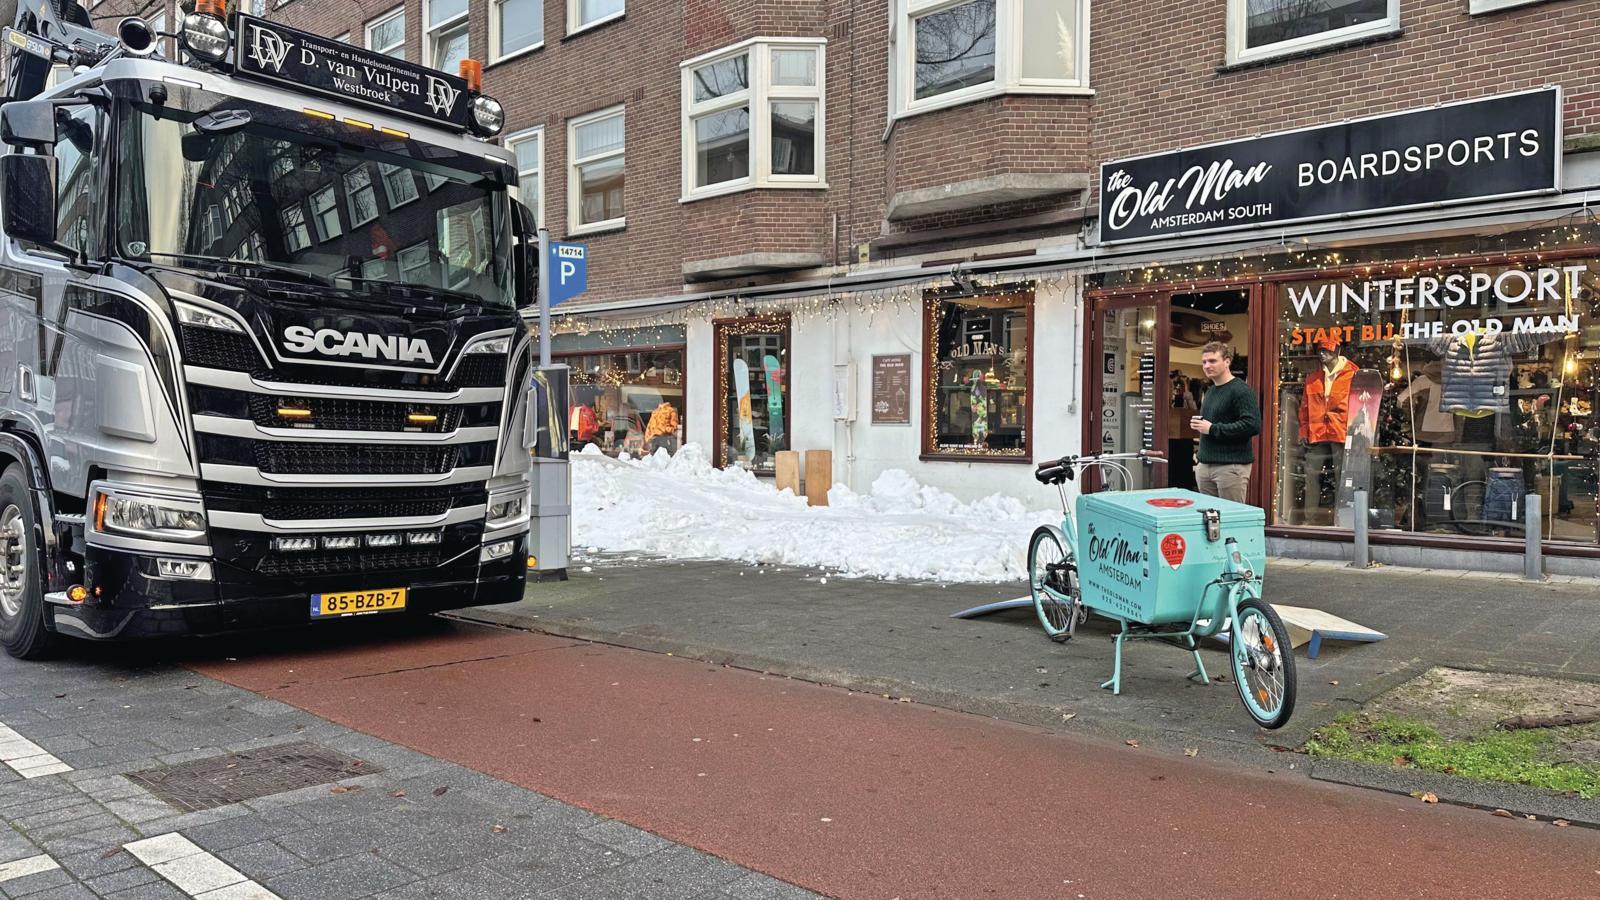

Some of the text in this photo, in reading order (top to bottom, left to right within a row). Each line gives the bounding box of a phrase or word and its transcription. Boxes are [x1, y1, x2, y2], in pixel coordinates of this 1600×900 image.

[300, 39, 420, 80] Transport- en Handelsonderneming
[300, 48, 420, 95] D. van Vulpen
[332, 76, 391, 103] Westbroek
[1298, 128, 1540, 188] BOARDSPORTS
[1107, 169, 1134, 192] the
[1108, 158, 1273, 231] Old Man
[1150, 202, 1273, 230] AMSTERDAM SOUTH
[560, 248, 583, 256] 14714
[561, 261, 576, 285] P
[1287, 265, 1588, 317] WINTERSPORT
[1202, 322, 1225, 330] SHOES
[1291, 313, 1580, 346] START BIJ THE OLD MAN
[283, 325, 435, 364] SCANIA
[951, 343, 970, 358] OLD
[1088, 535, 1142, 566] Old Man
[1098, 562, 1142, 592] AMSTERDAM
[327, 591, 400, 611] 85-BZB-7
